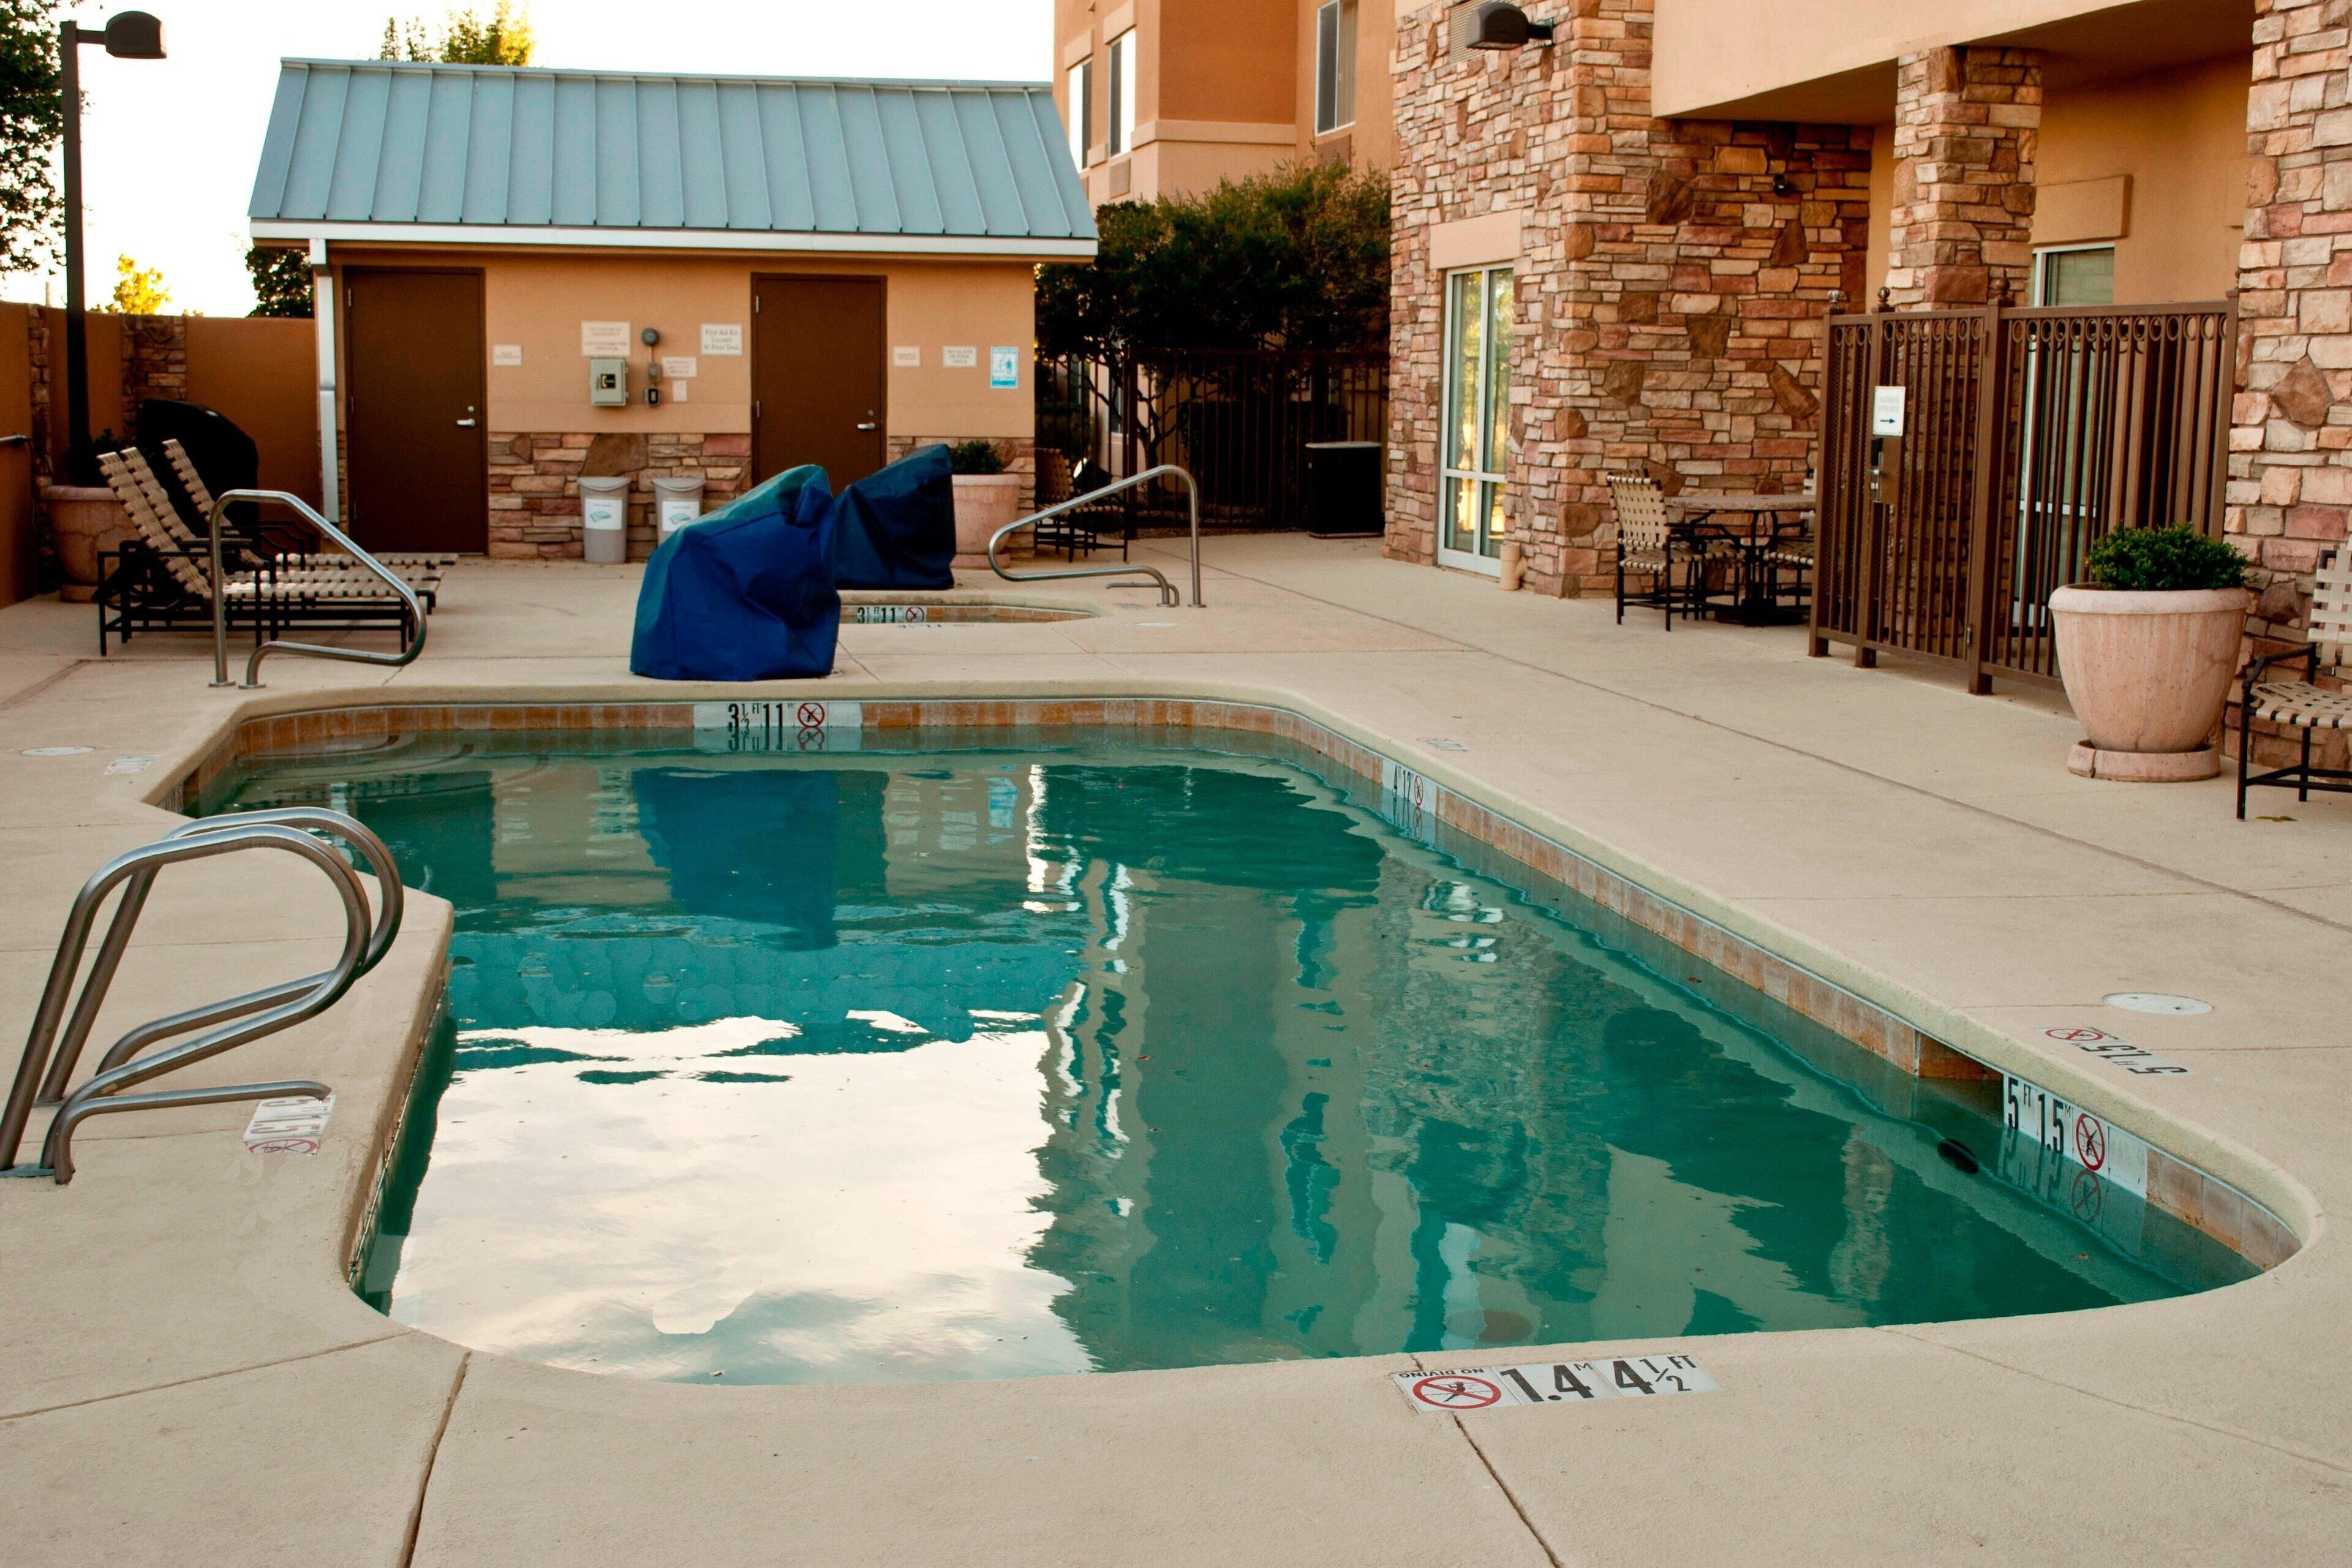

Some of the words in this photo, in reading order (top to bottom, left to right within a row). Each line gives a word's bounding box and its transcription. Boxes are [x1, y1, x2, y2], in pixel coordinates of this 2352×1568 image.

[728, 703, 739, 729] 3
[752, 703, 760, 714] FT
[2008, 1077, 2019, 1131] 5
[2023, 1084, 2032, 1107] FT
[2038, 1093, 2064, 1155] 1.5
[1398, 1370, 1457, 1379] DIVING
[1499, 1364, 1595, 1403] 1.4
[1574, 1362, 1594, 1371] M
[1667, 1355, 1697, 1370] FT
